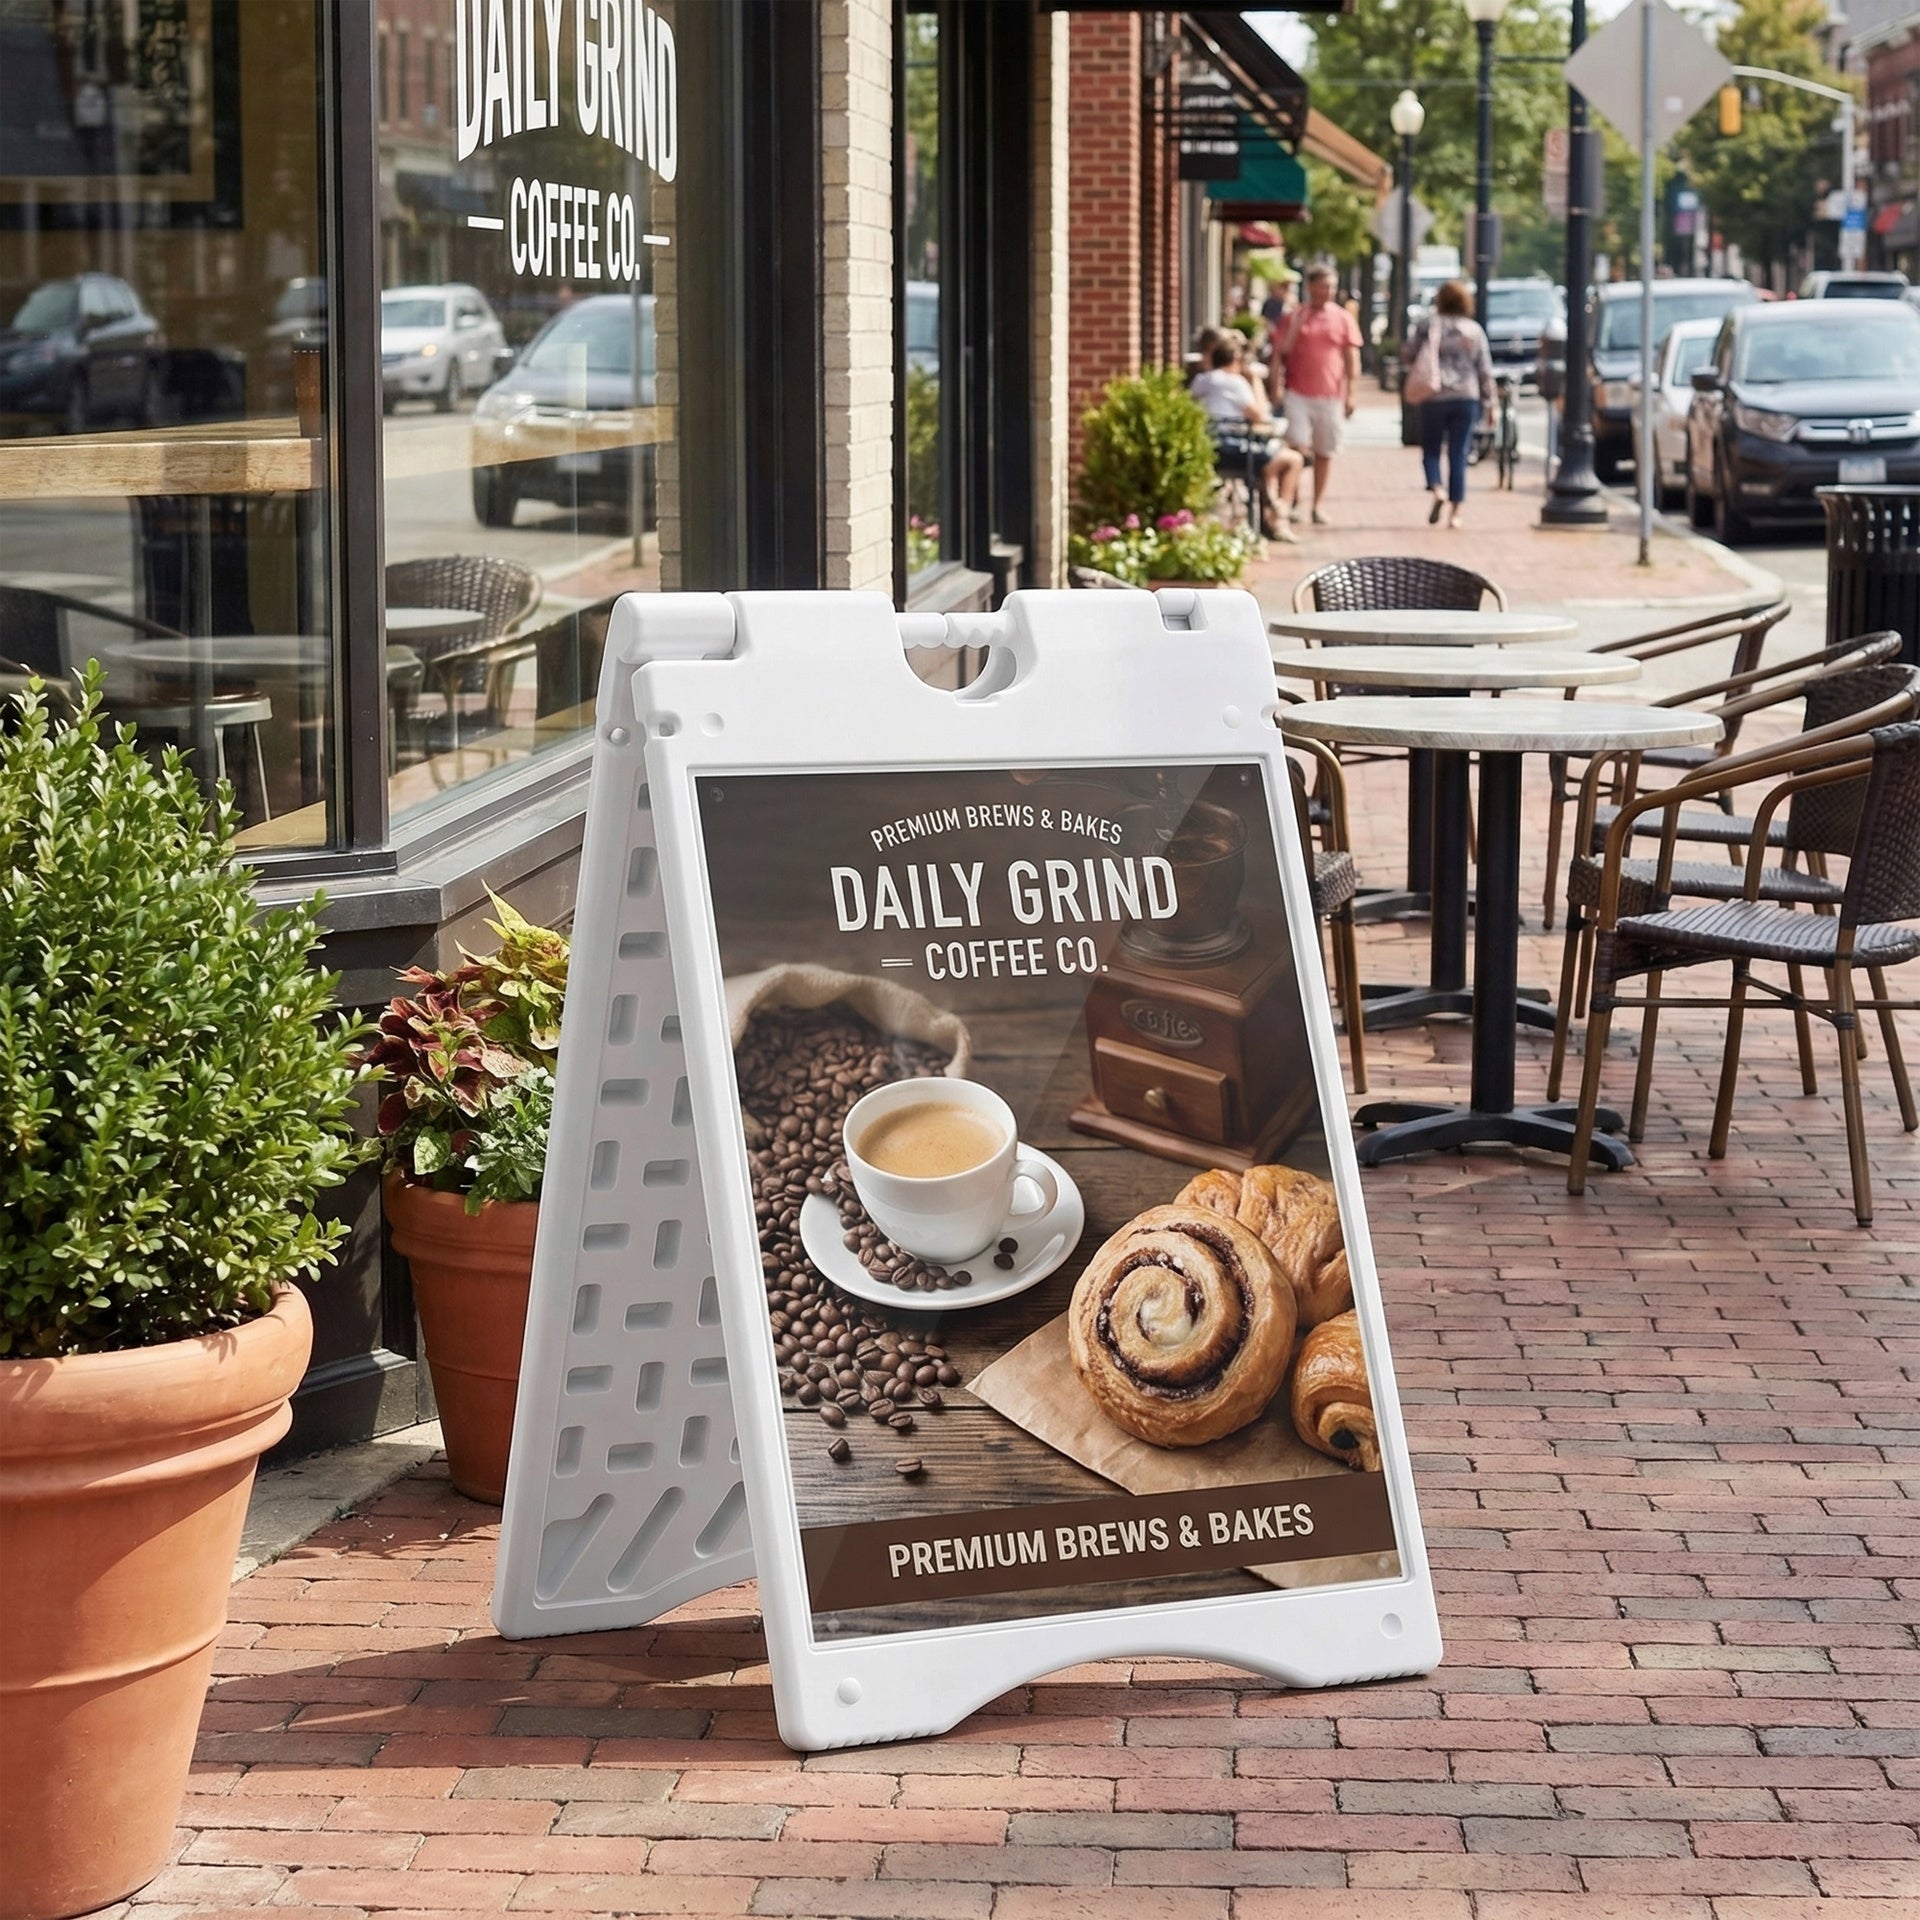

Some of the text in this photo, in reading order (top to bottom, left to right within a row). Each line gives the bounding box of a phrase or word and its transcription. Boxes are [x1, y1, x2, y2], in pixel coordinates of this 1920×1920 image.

[455, 0, 678, 183] DAILY GRIND
[510, 176, 641, 282] COFFEE CO.
[870, 804, 1123, 852] PREMIUM BREWS & BAKES
[830, 856, 1179, 932] DAILY GRIND
[925, 936, 1109, 980] COFFEE CO.
[887, 1503, 1316, 1578] PREMIUM BREWS & BAKES
